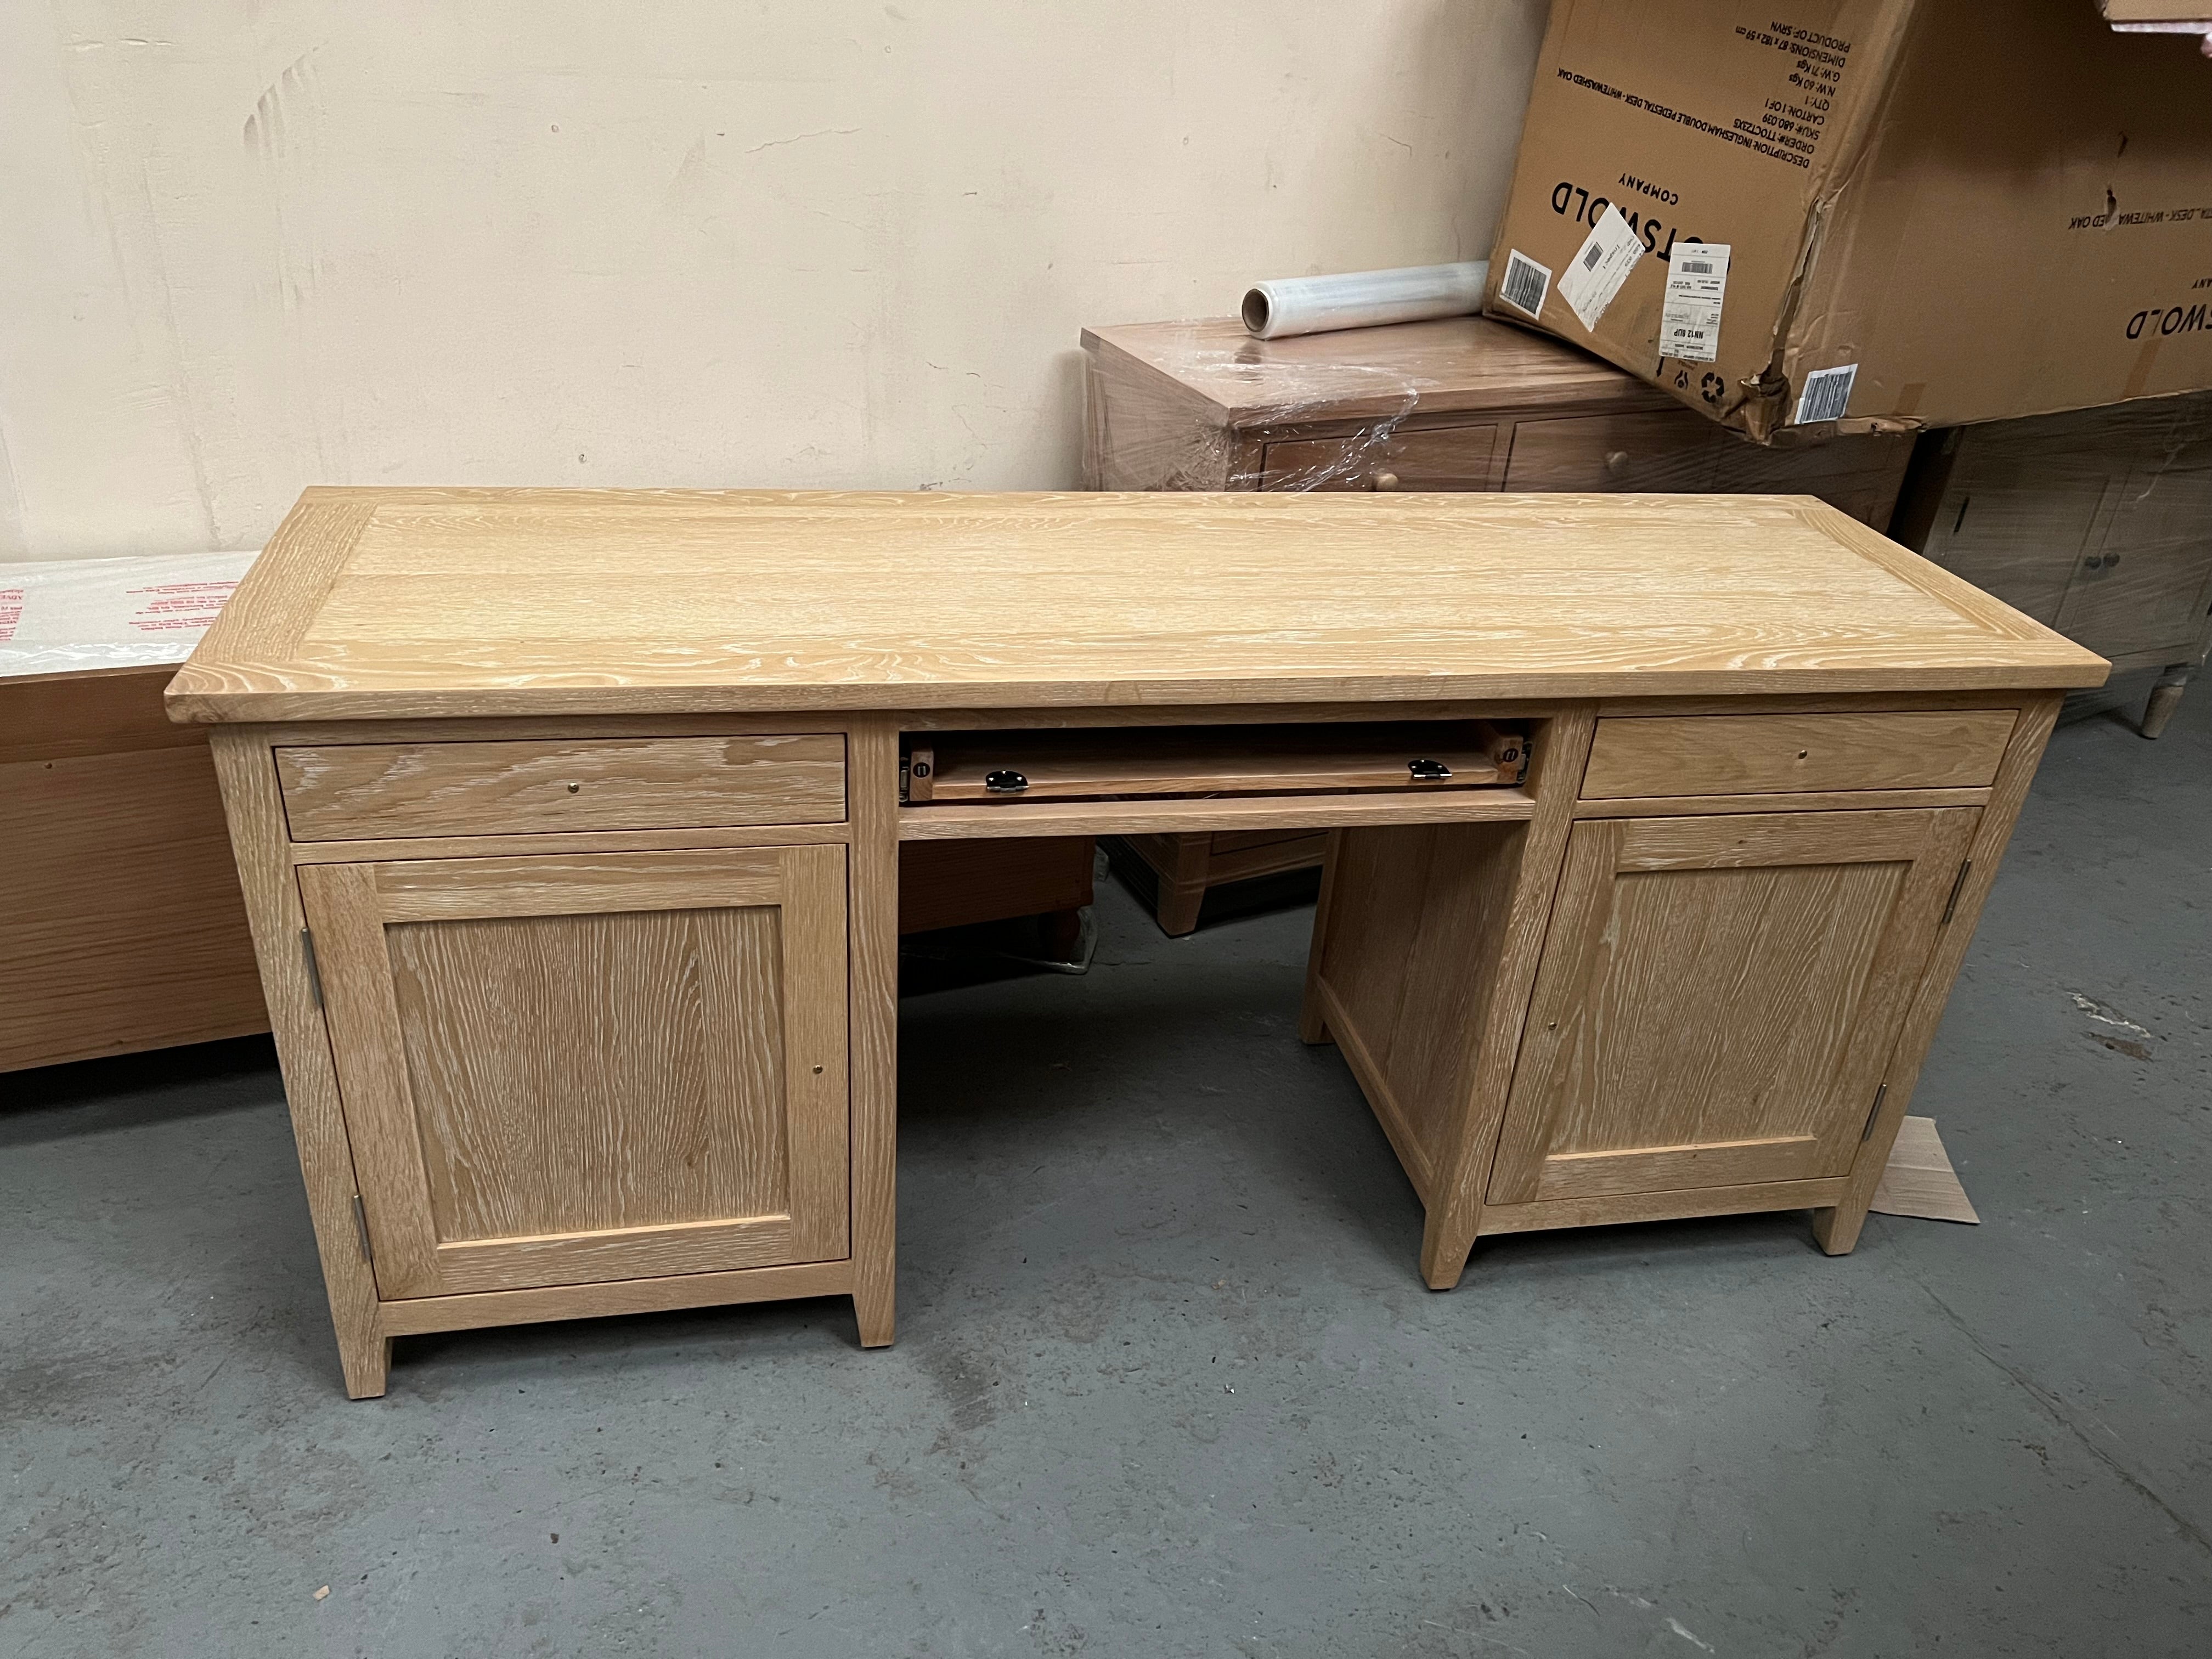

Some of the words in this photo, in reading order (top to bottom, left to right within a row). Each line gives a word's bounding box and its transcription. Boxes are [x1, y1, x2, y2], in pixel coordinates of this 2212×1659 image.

[1735, 26, 1746, 36] cm
[1746, 30, 1756, 41] 59
[1770, 21, 1793, 36] SRVN
[1793, 28, 1807, 40] OF:
[1760, 34, 1773, 46] 182
[1778, 40, 1788, 50] 87
[1806, 32, 1851, 53] PRODUCT
[1790, 43, 1846, 68] DIMENSIONS:
[1796, 59, 1812, 73] Kgs
[1557, 67, 1572, 81] OAK
[1788, 74, 1803, 87] Kgs
[1820, 68, 1840, 82] G.W:
[1573, 75, 1622, 100] WHITEWASHED
[1804, 80, 1815, 90] 60
[1816, 82, 1836, 97] N.W:
[1624, 94, 1643, 108] DESK
[1764, 98, 1769, 108] 1
[1769, 99, 1782, 111] OF
[1805, 95, 1809, 104] 1
[1812, 97, 1830, 111] QTY:
[1644, 100, 1677, 120] PEDESTAL
[1782, 104, 1786, 113] 1
[1788, 105, 1825, 125] CARTON:
[1677, 113, 1707, 132] DOUBLE
[1762, 113, 1795, 132] 680.039
[1707, 124, 1752, 148] INGLESHAM
[1795, 124, 1820, 140] SKU#:
[1778, 133, 1814, 154] ORDER#:
[1753, 141, 1809, 168] DESCRIPTION:
[1618, 173, 1678, 206] COMPANY
[2092, 212, 2164, 227] WHITEWAED
[2169, 209, 2194, 221] DESK
[2068, 216, 2091, 229] OAK
